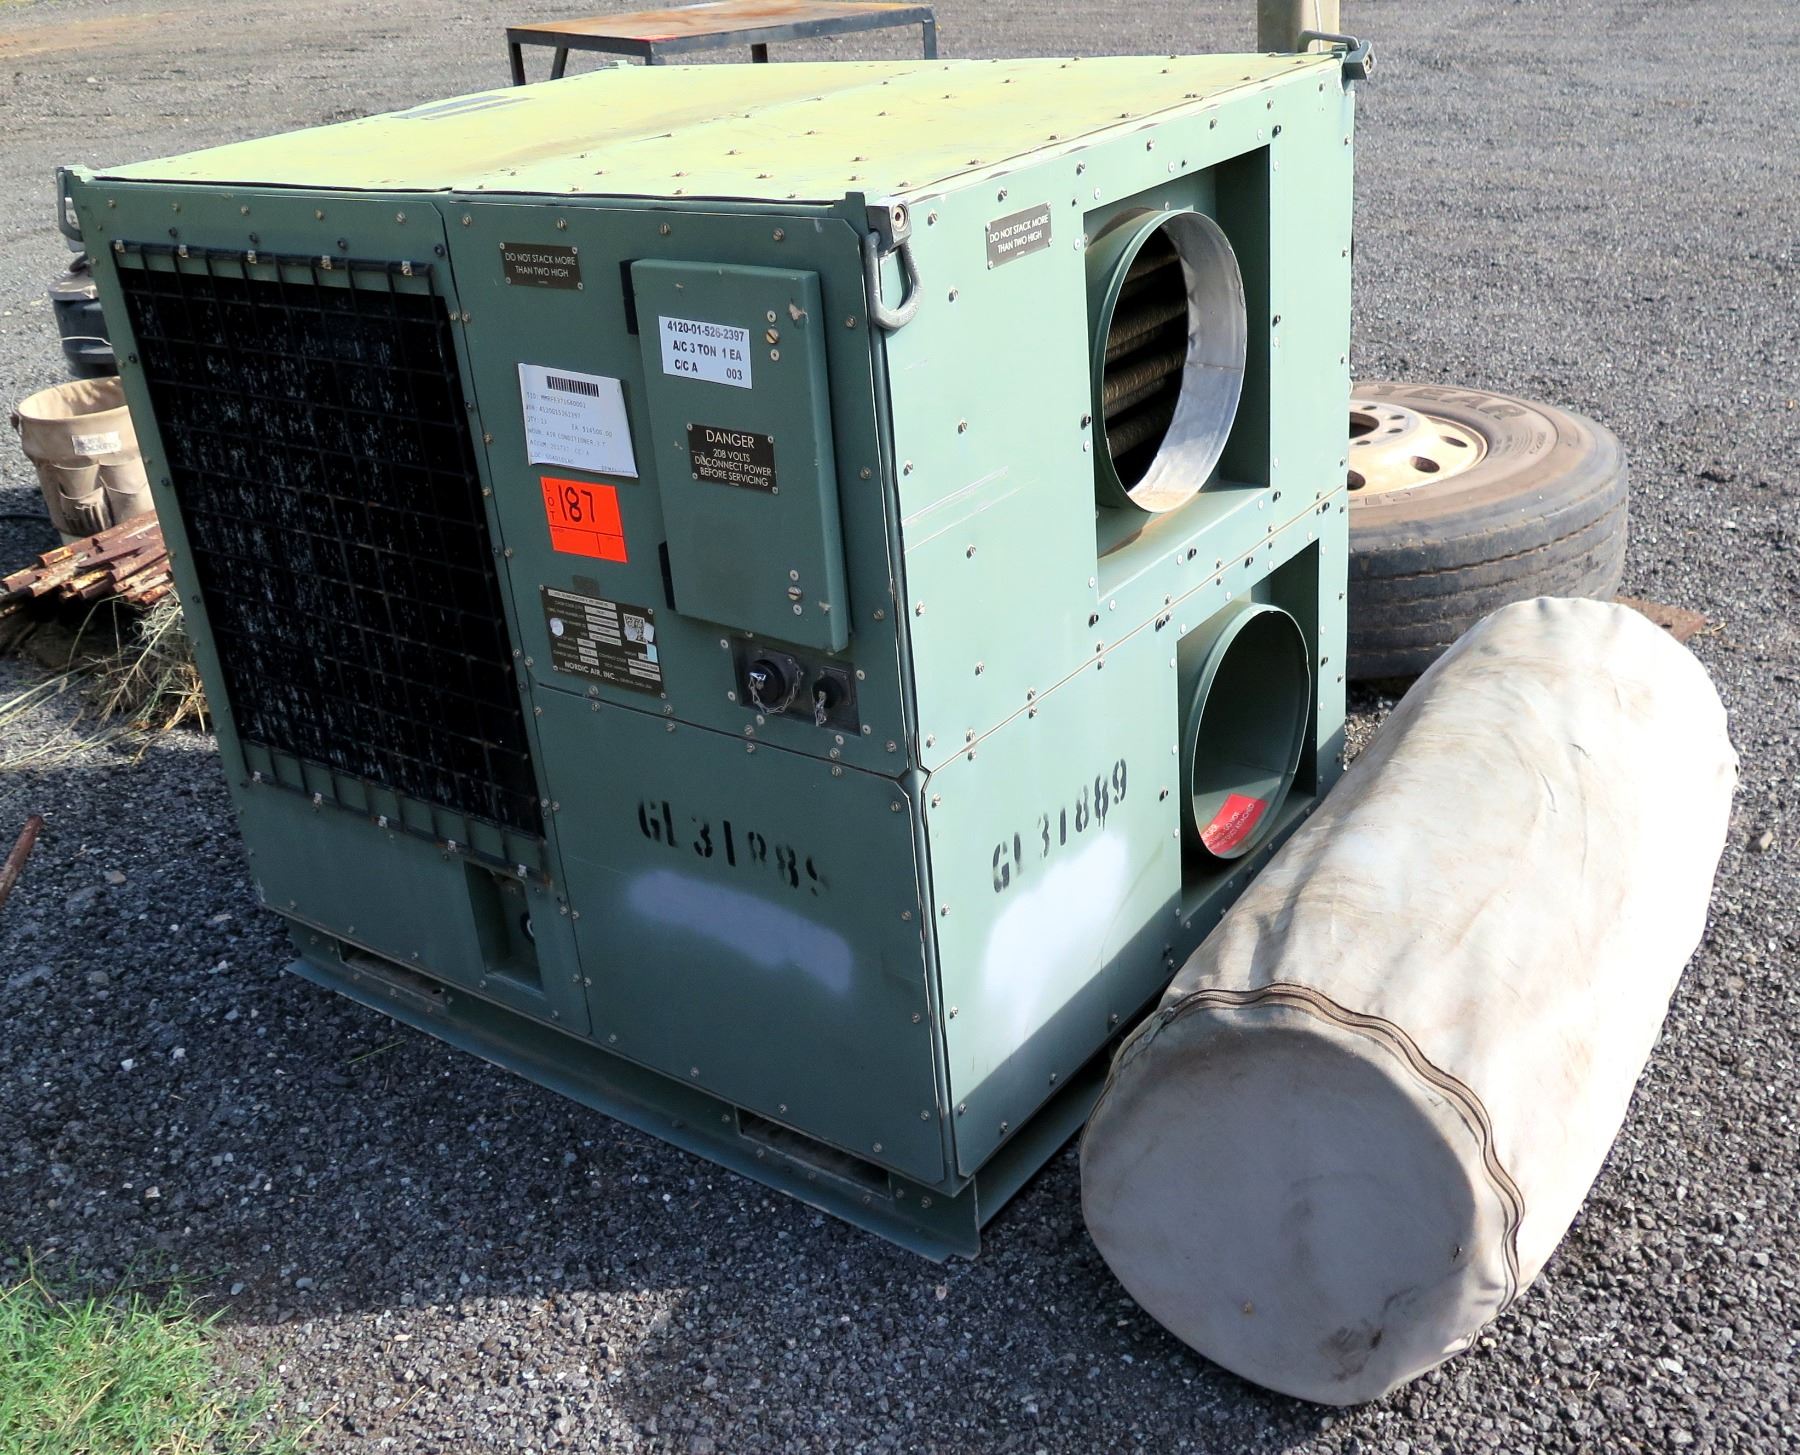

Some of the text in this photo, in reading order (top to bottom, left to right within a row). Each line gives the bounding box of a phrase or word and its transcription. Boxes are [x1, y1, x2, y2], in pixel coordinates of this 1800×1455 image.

[989, 214, 1049, 243] DO NOT STACK MORE
[997, 230, 1043, 254] THAN TWO HIGH
[505, 253, 576, 266] DO NOT STACK MORE
[515, 265, 569, 278] THAN TWO HIGH
[667, 320, 745, 342] 4120-01-526-2397
[673, 340, 742, 362] A/C 3 TON 1 EA
[674, 359, 743, 381] C/C A 003
[705, 429, 755, 449] DANGER
[712, 448, 751, 462] 208 VOLTS
[700, 467, 769, 487] BEFORE SERVICING
[744, 464, 772, 477] POWER
[544, 482, 555, 520] LOT
[558, 485, 596, 523] 187
[564, 661, 590, 673] NORDIC
